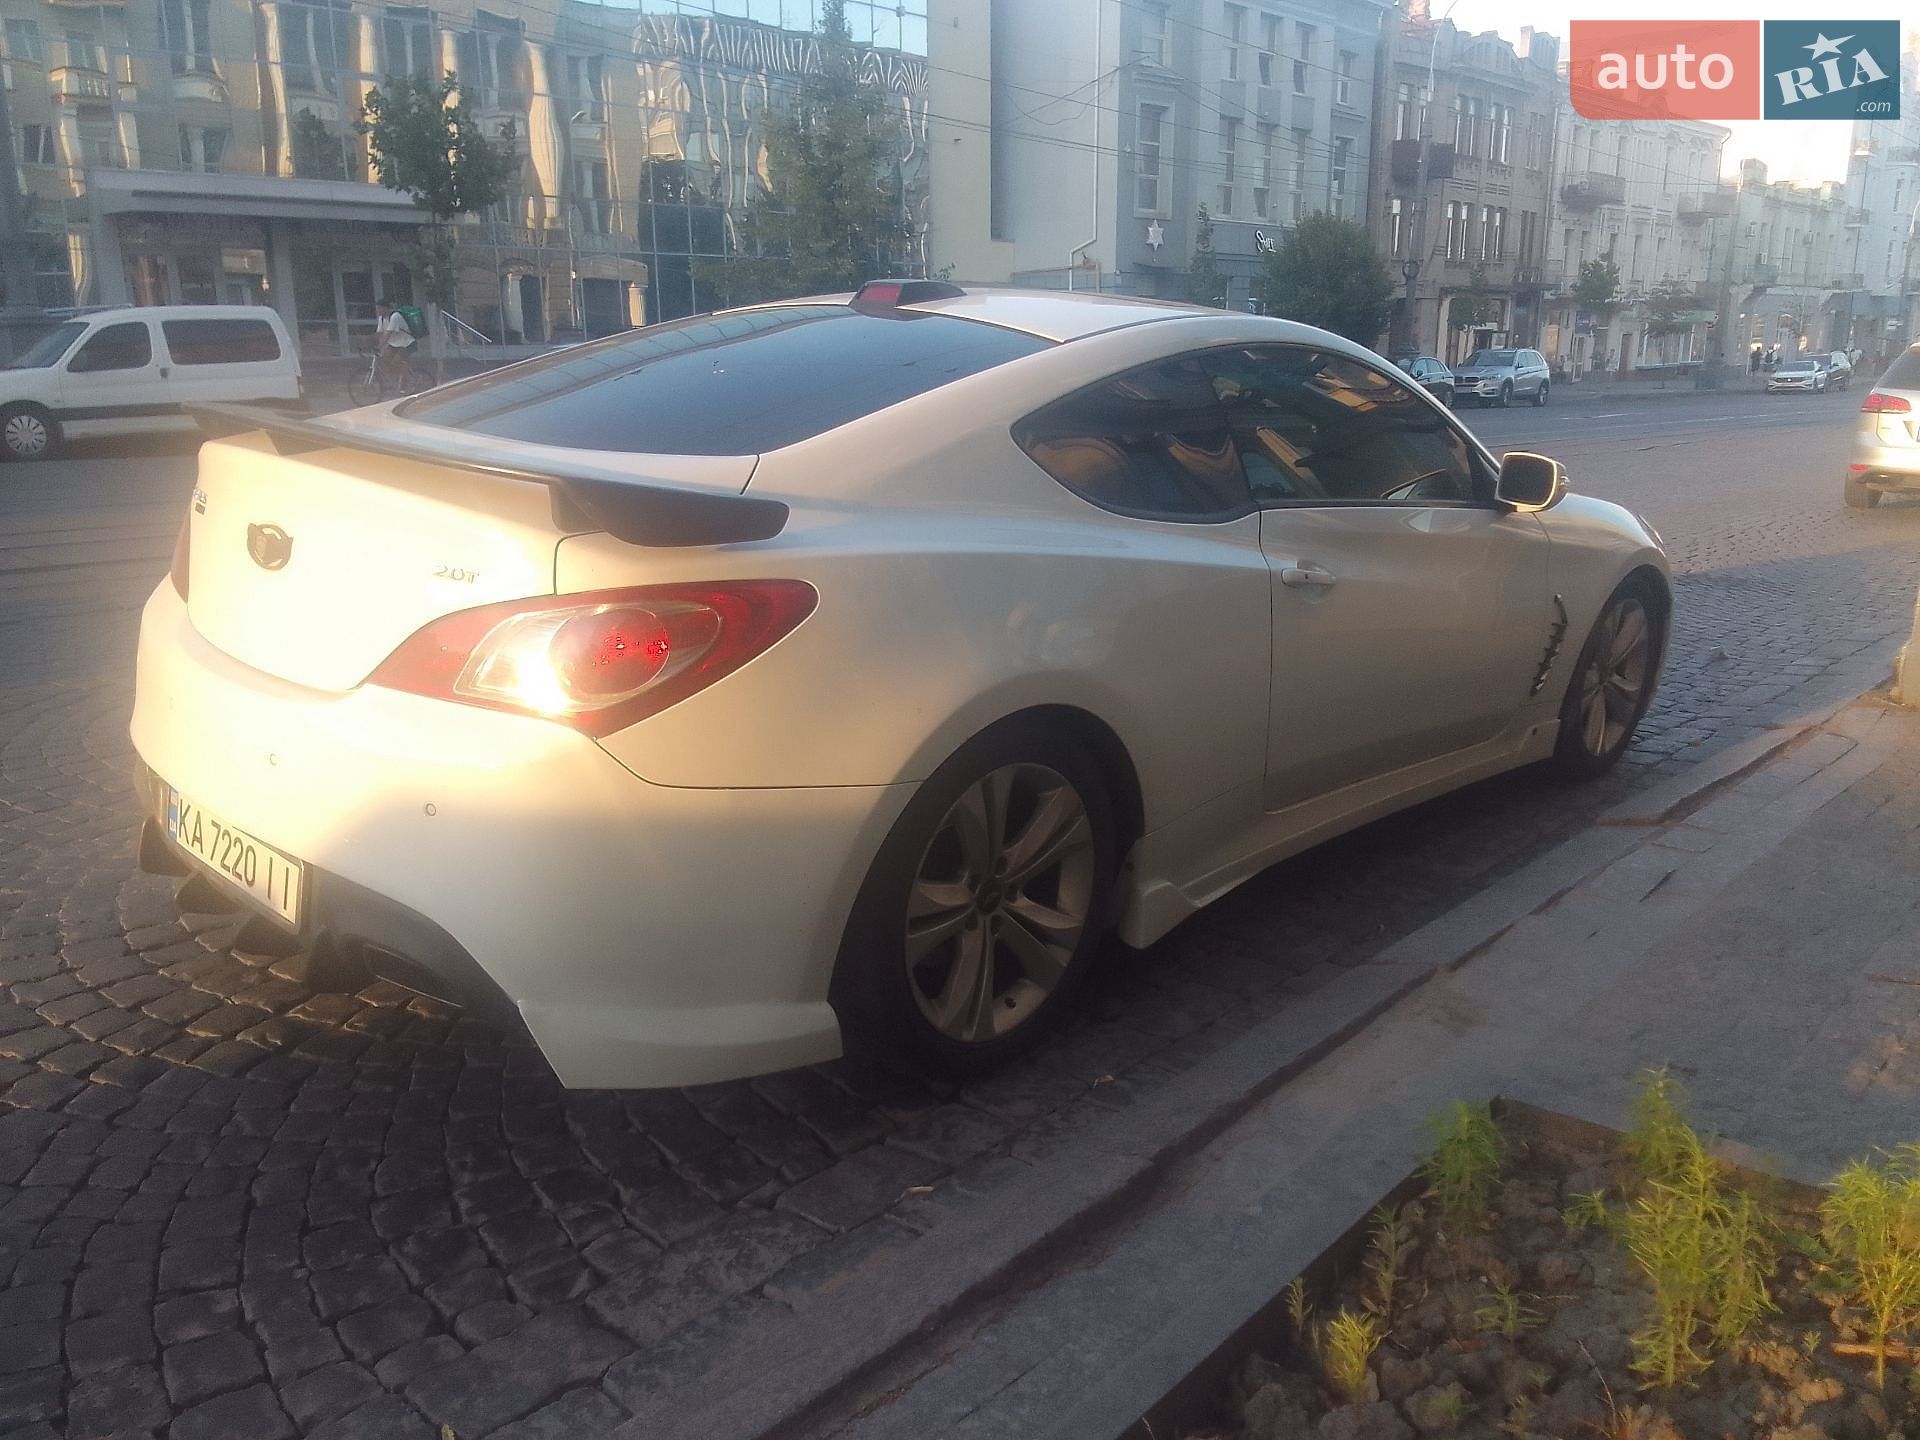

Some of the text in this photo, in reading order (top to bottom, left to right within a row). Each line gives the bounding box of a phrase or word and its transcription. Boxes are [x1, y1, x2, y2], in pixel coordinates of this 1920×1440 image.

[179, 799, 289, 911] KA 7220 II
